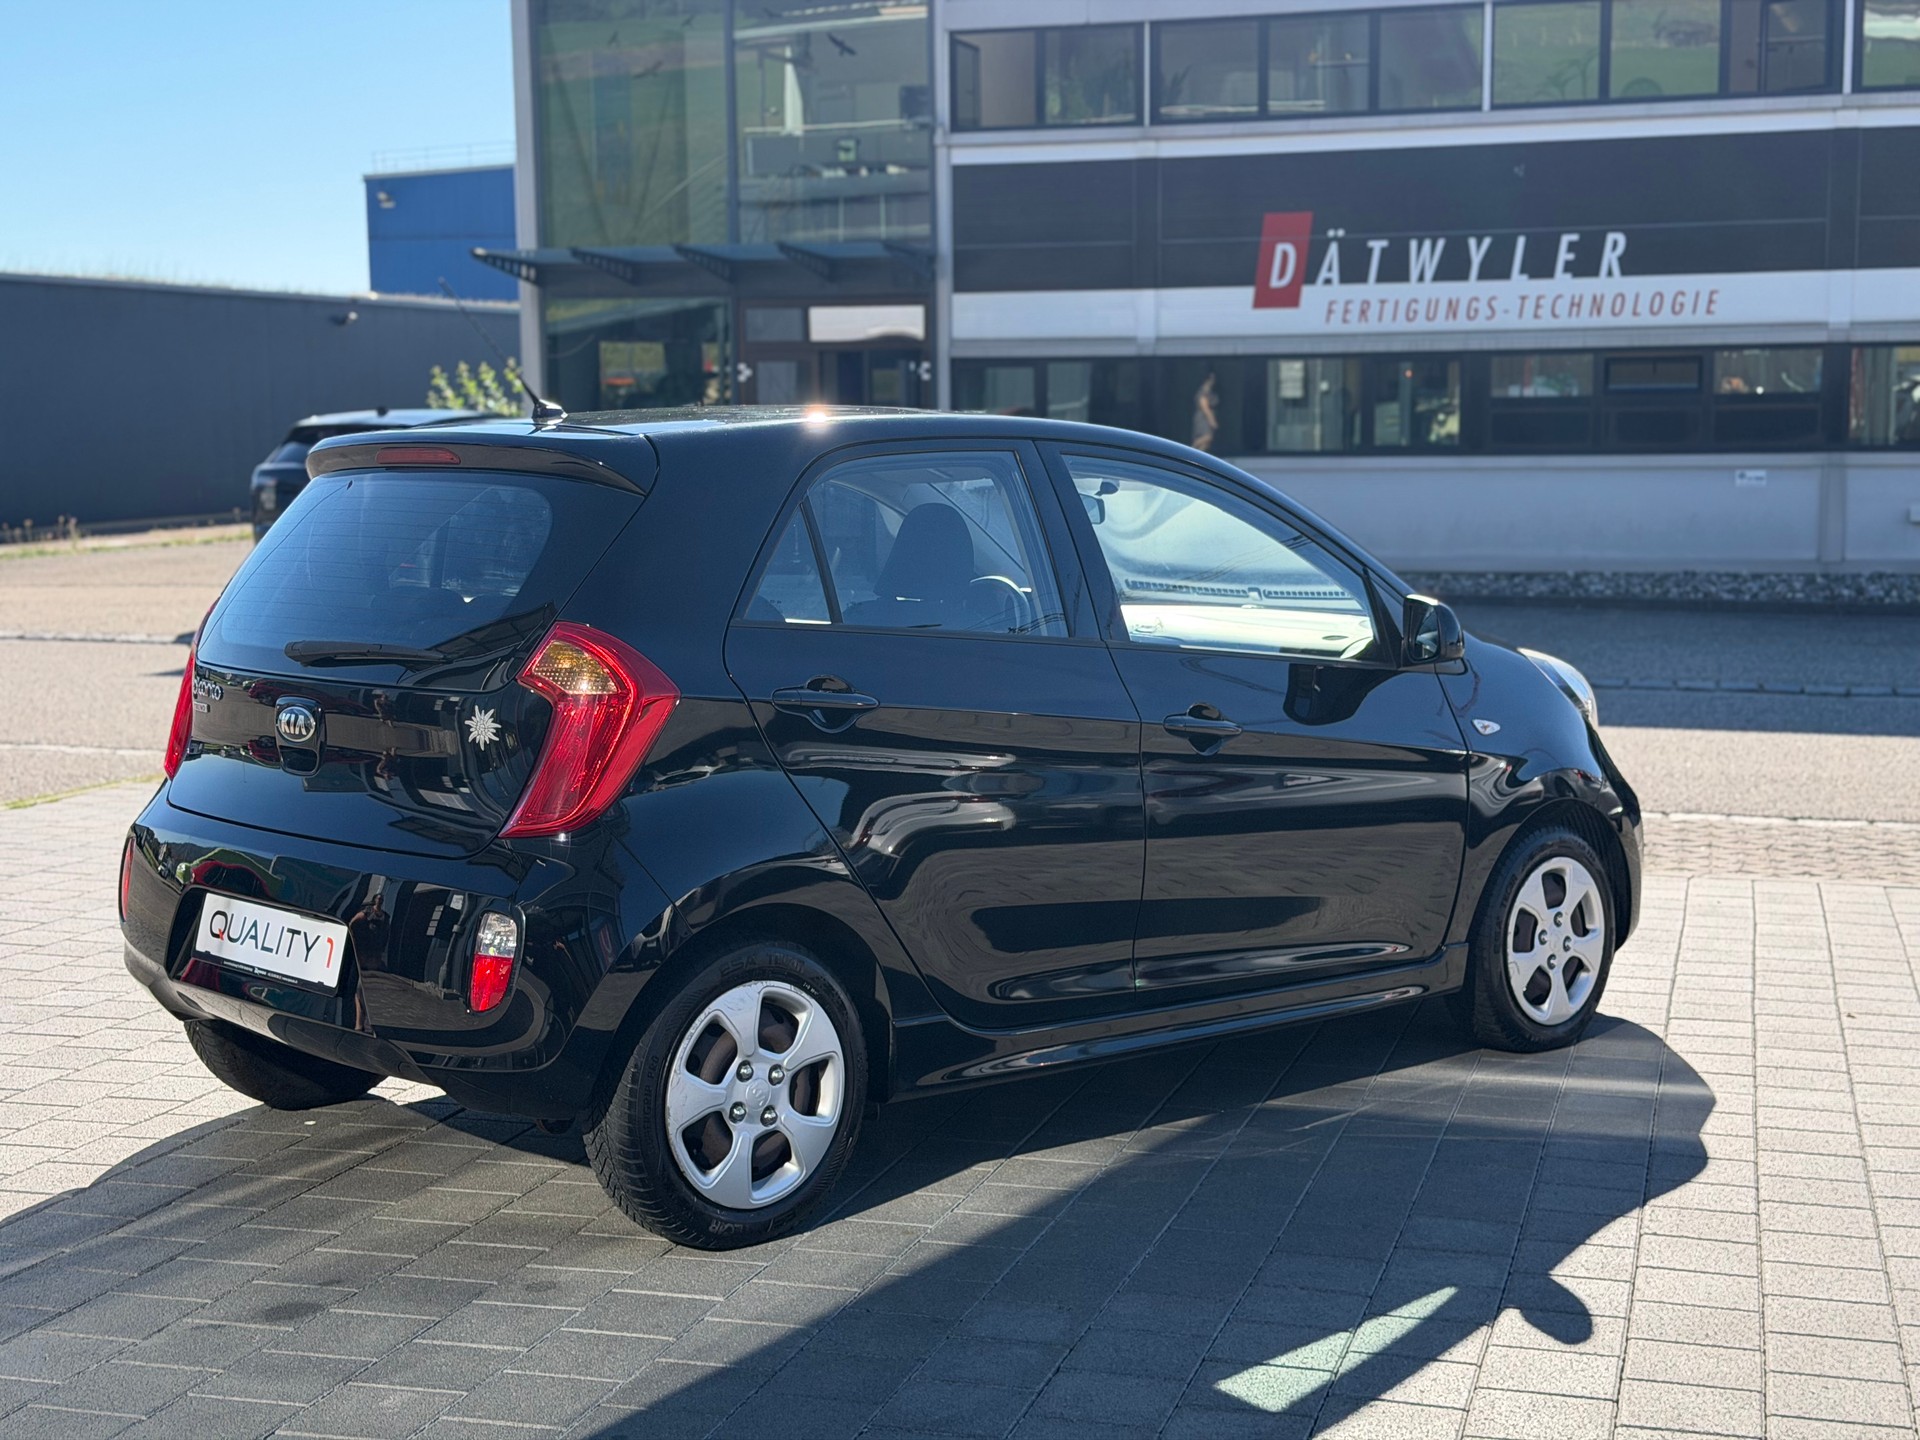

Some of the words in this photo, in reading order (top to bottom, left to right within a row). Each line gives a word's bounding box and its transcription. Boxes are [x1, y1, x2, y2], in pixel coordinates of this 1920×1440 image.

[1269, 228, 1627, 288] DÄTWYLER
[1325, 289, 1719, 324] FERTIGUNGS-TECHNOLOGIE
[280, 712, 308, 736] KIA
